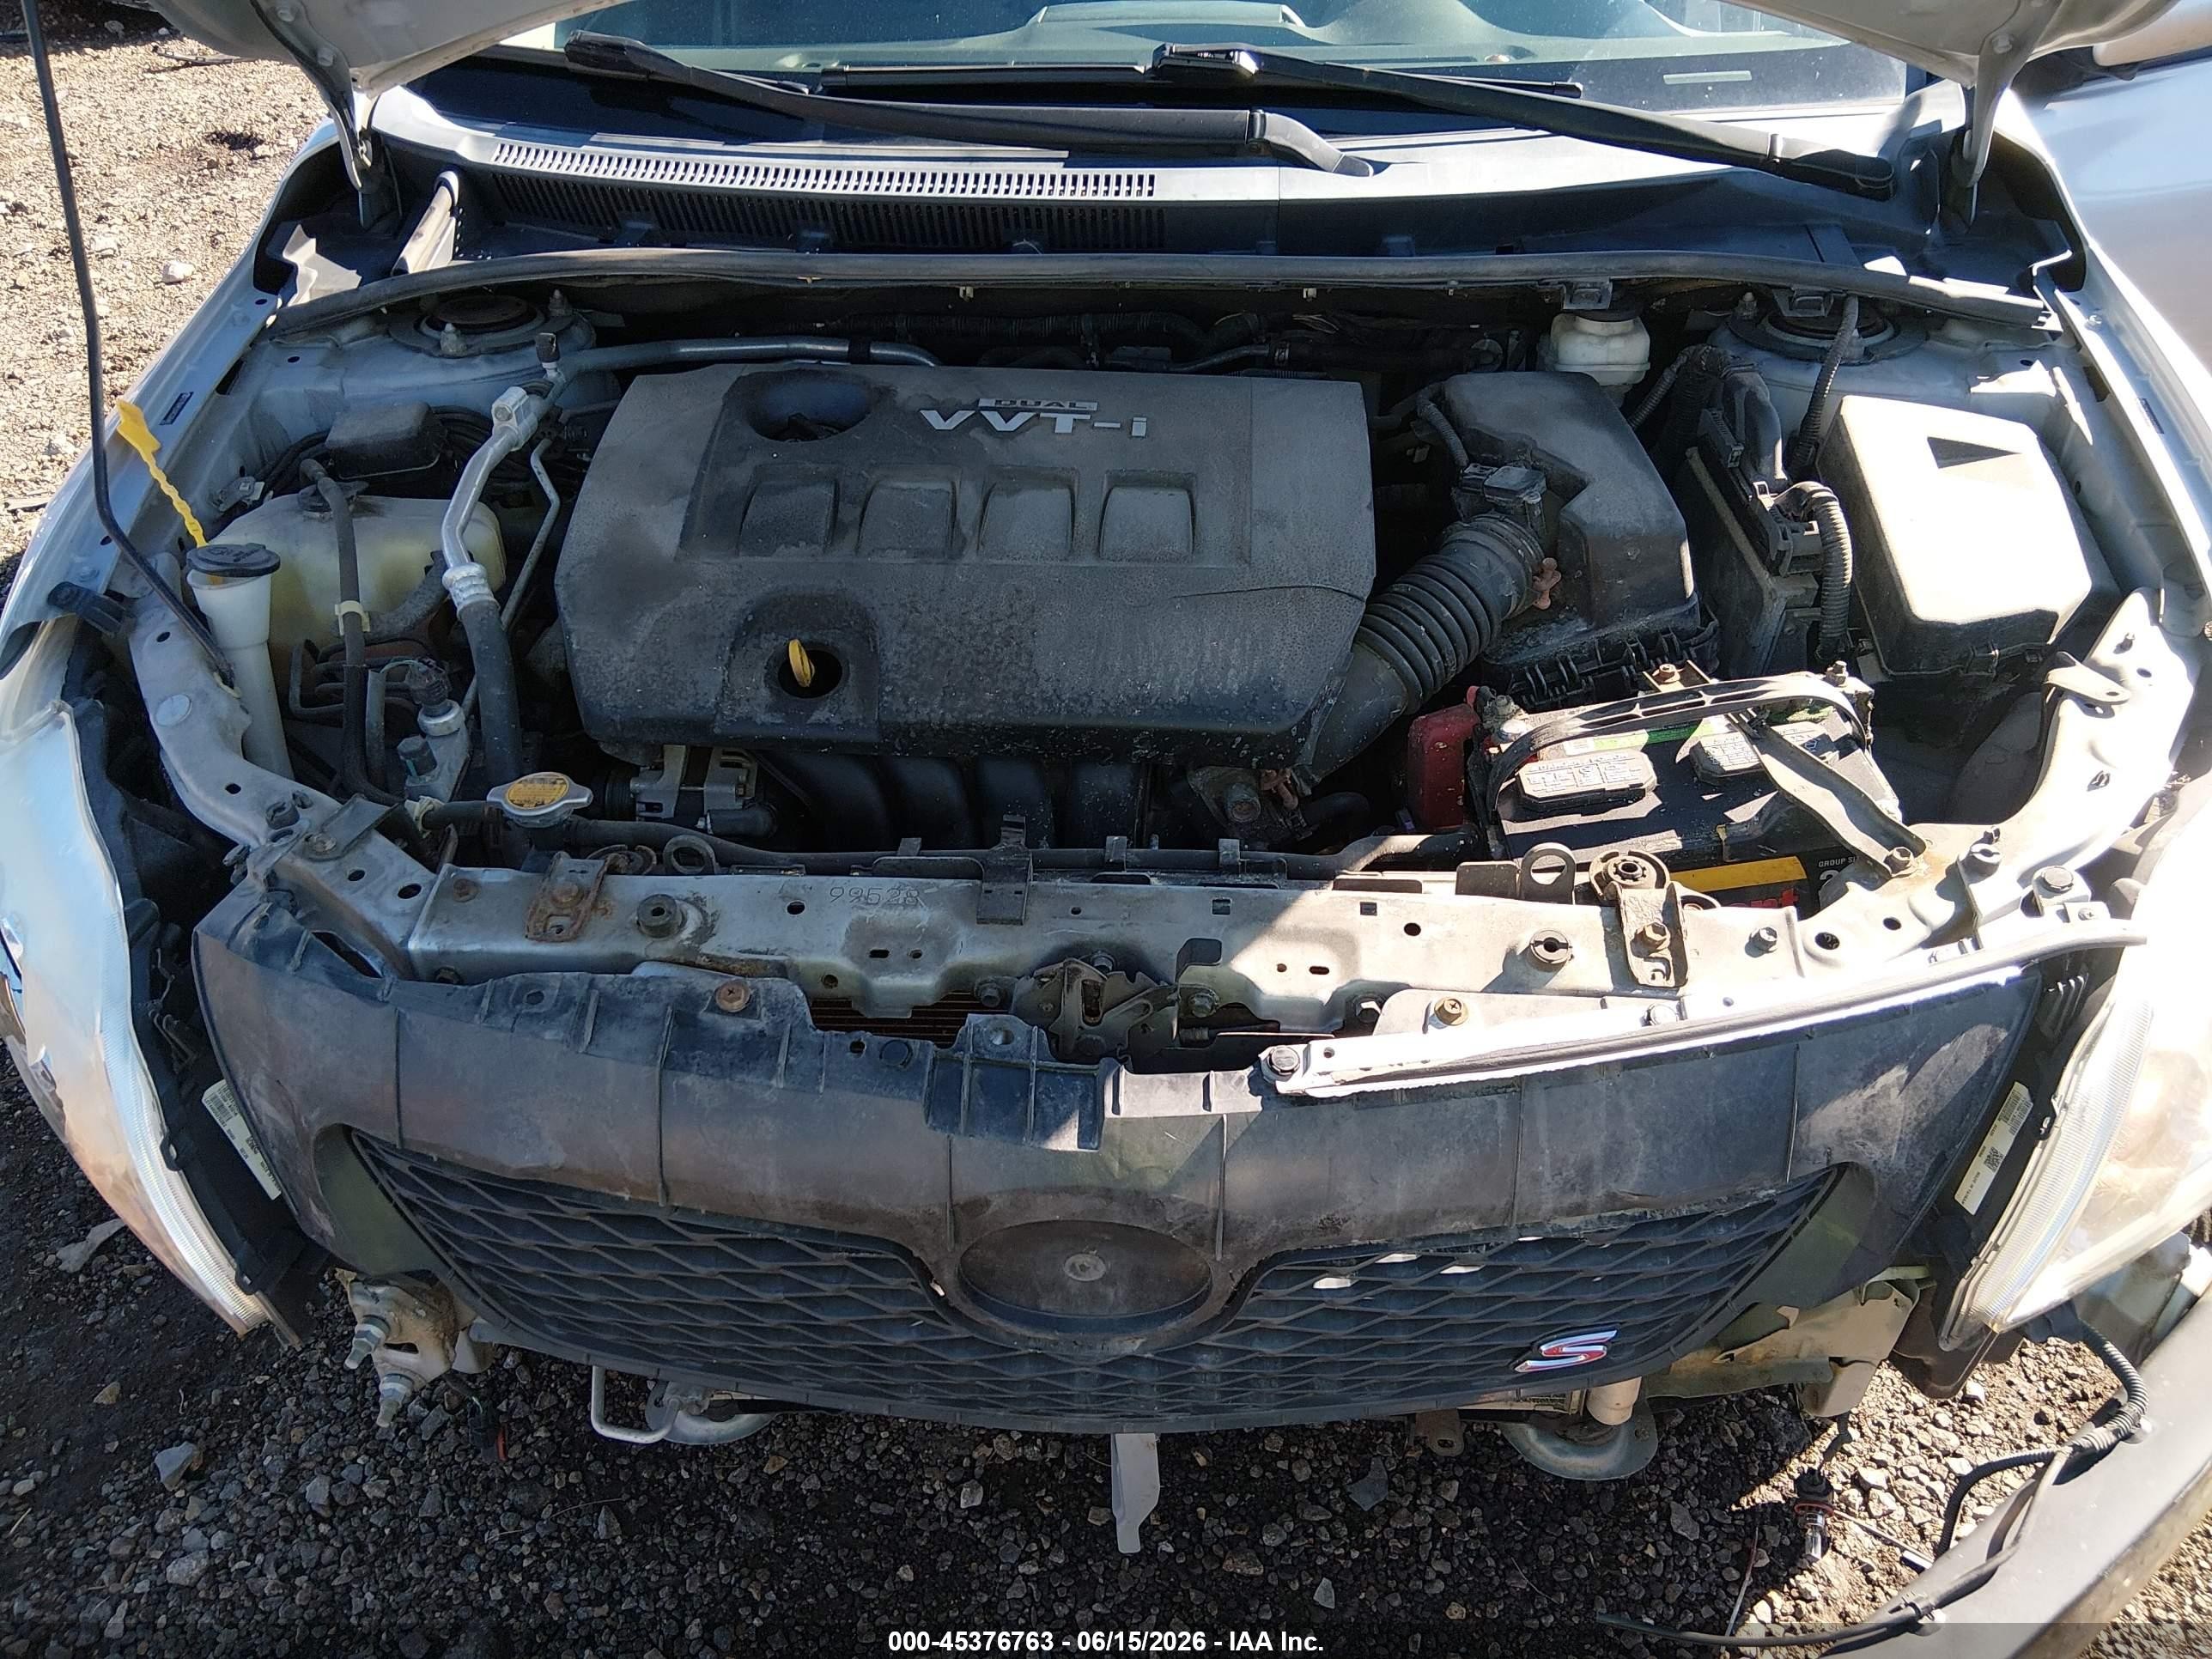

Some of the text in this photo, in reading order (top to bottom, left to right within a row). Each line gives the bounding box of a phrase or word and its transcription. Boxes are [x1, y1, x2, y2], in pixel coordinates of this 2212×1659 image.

[994, 398, 1088, 410] DUAL
[920, 409, 1148, 438] VVT-i
[1818, 858, 1846, 867] GROUP
